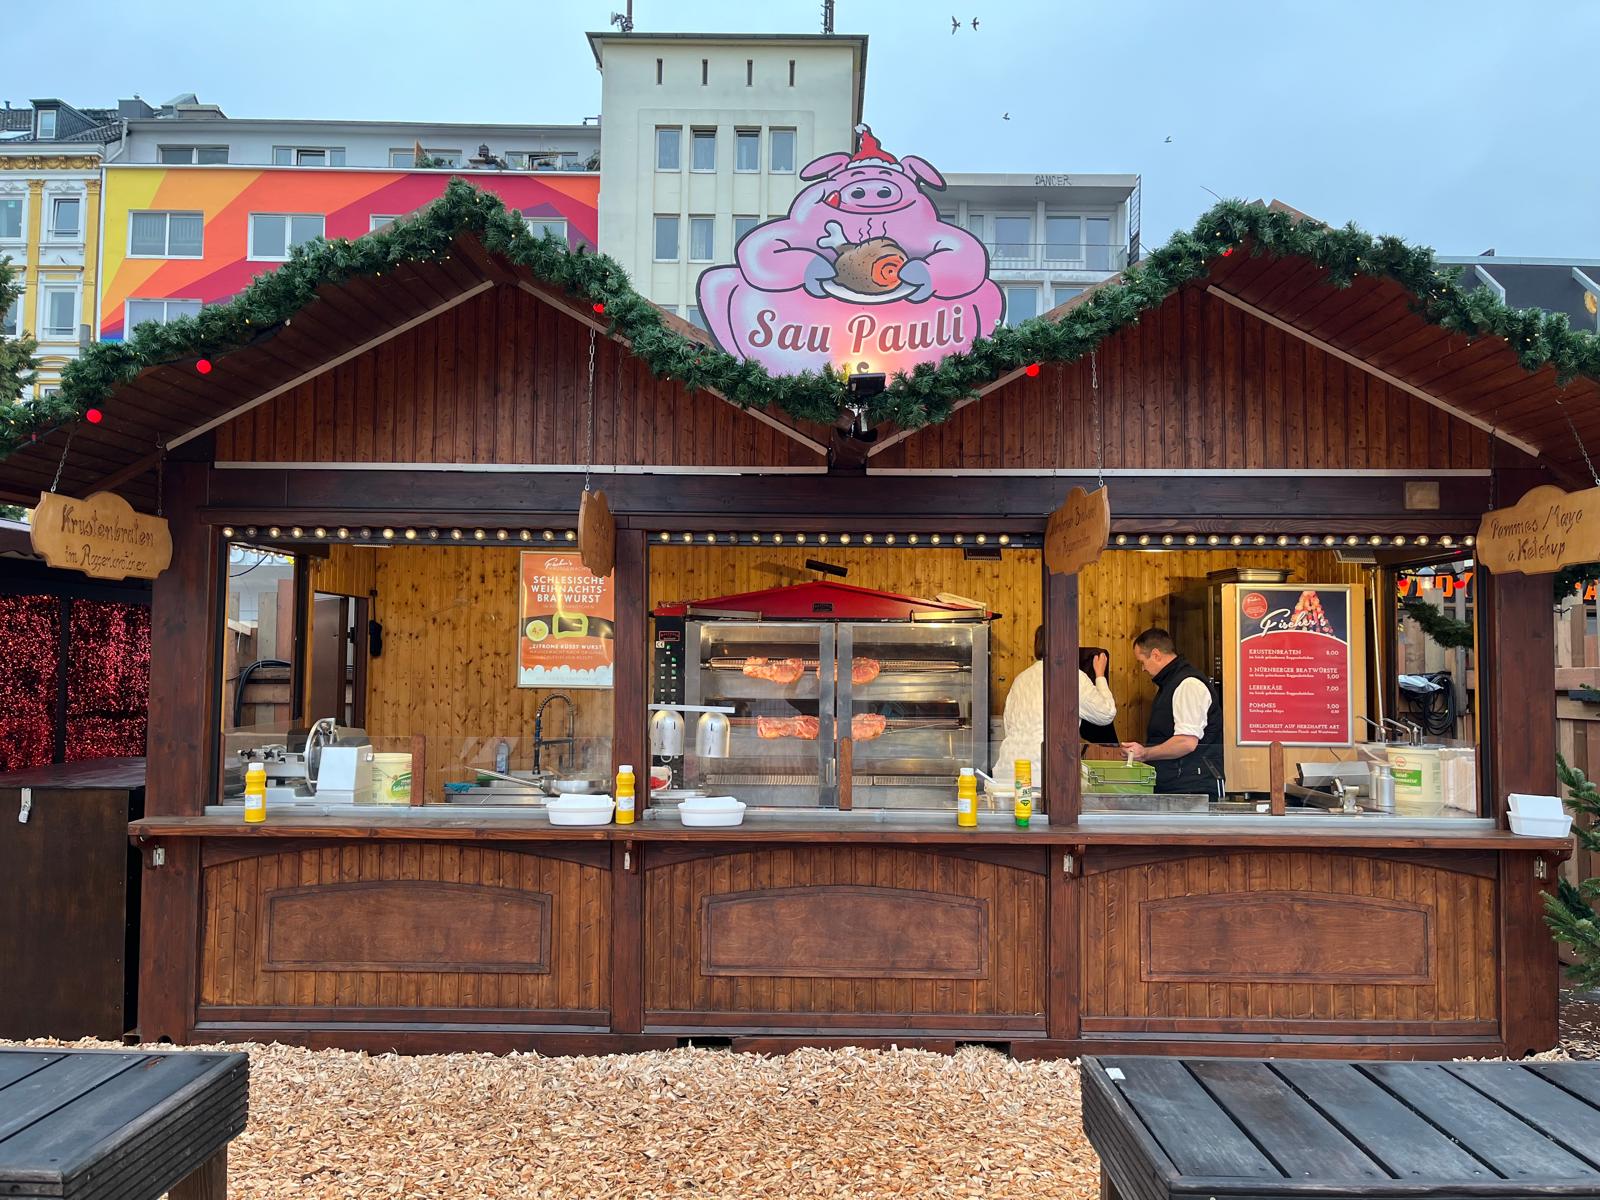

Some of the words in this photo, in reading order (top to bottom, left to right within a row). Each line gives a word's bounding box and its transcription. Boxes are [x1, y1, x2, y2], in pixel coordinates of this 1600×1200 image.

[748, 308, 831, 353] Sau
[847, 305, 964, 354] Pauli
[61, 504, 154, 547] Krustenbraten
[1490, 518, 1538, 540] Pommes
[1542, 504, 1583, 534] Mayo
[1517, 534, 1566, 562] Ketchup
[531, 584, 607, 593] WEIHNACHTS-
[533, 575, 605, 585] SCHLESISCHE
[537, 594, 601, 603] BRATWURST
[1260, 608, 1327, 638] Fischer's
